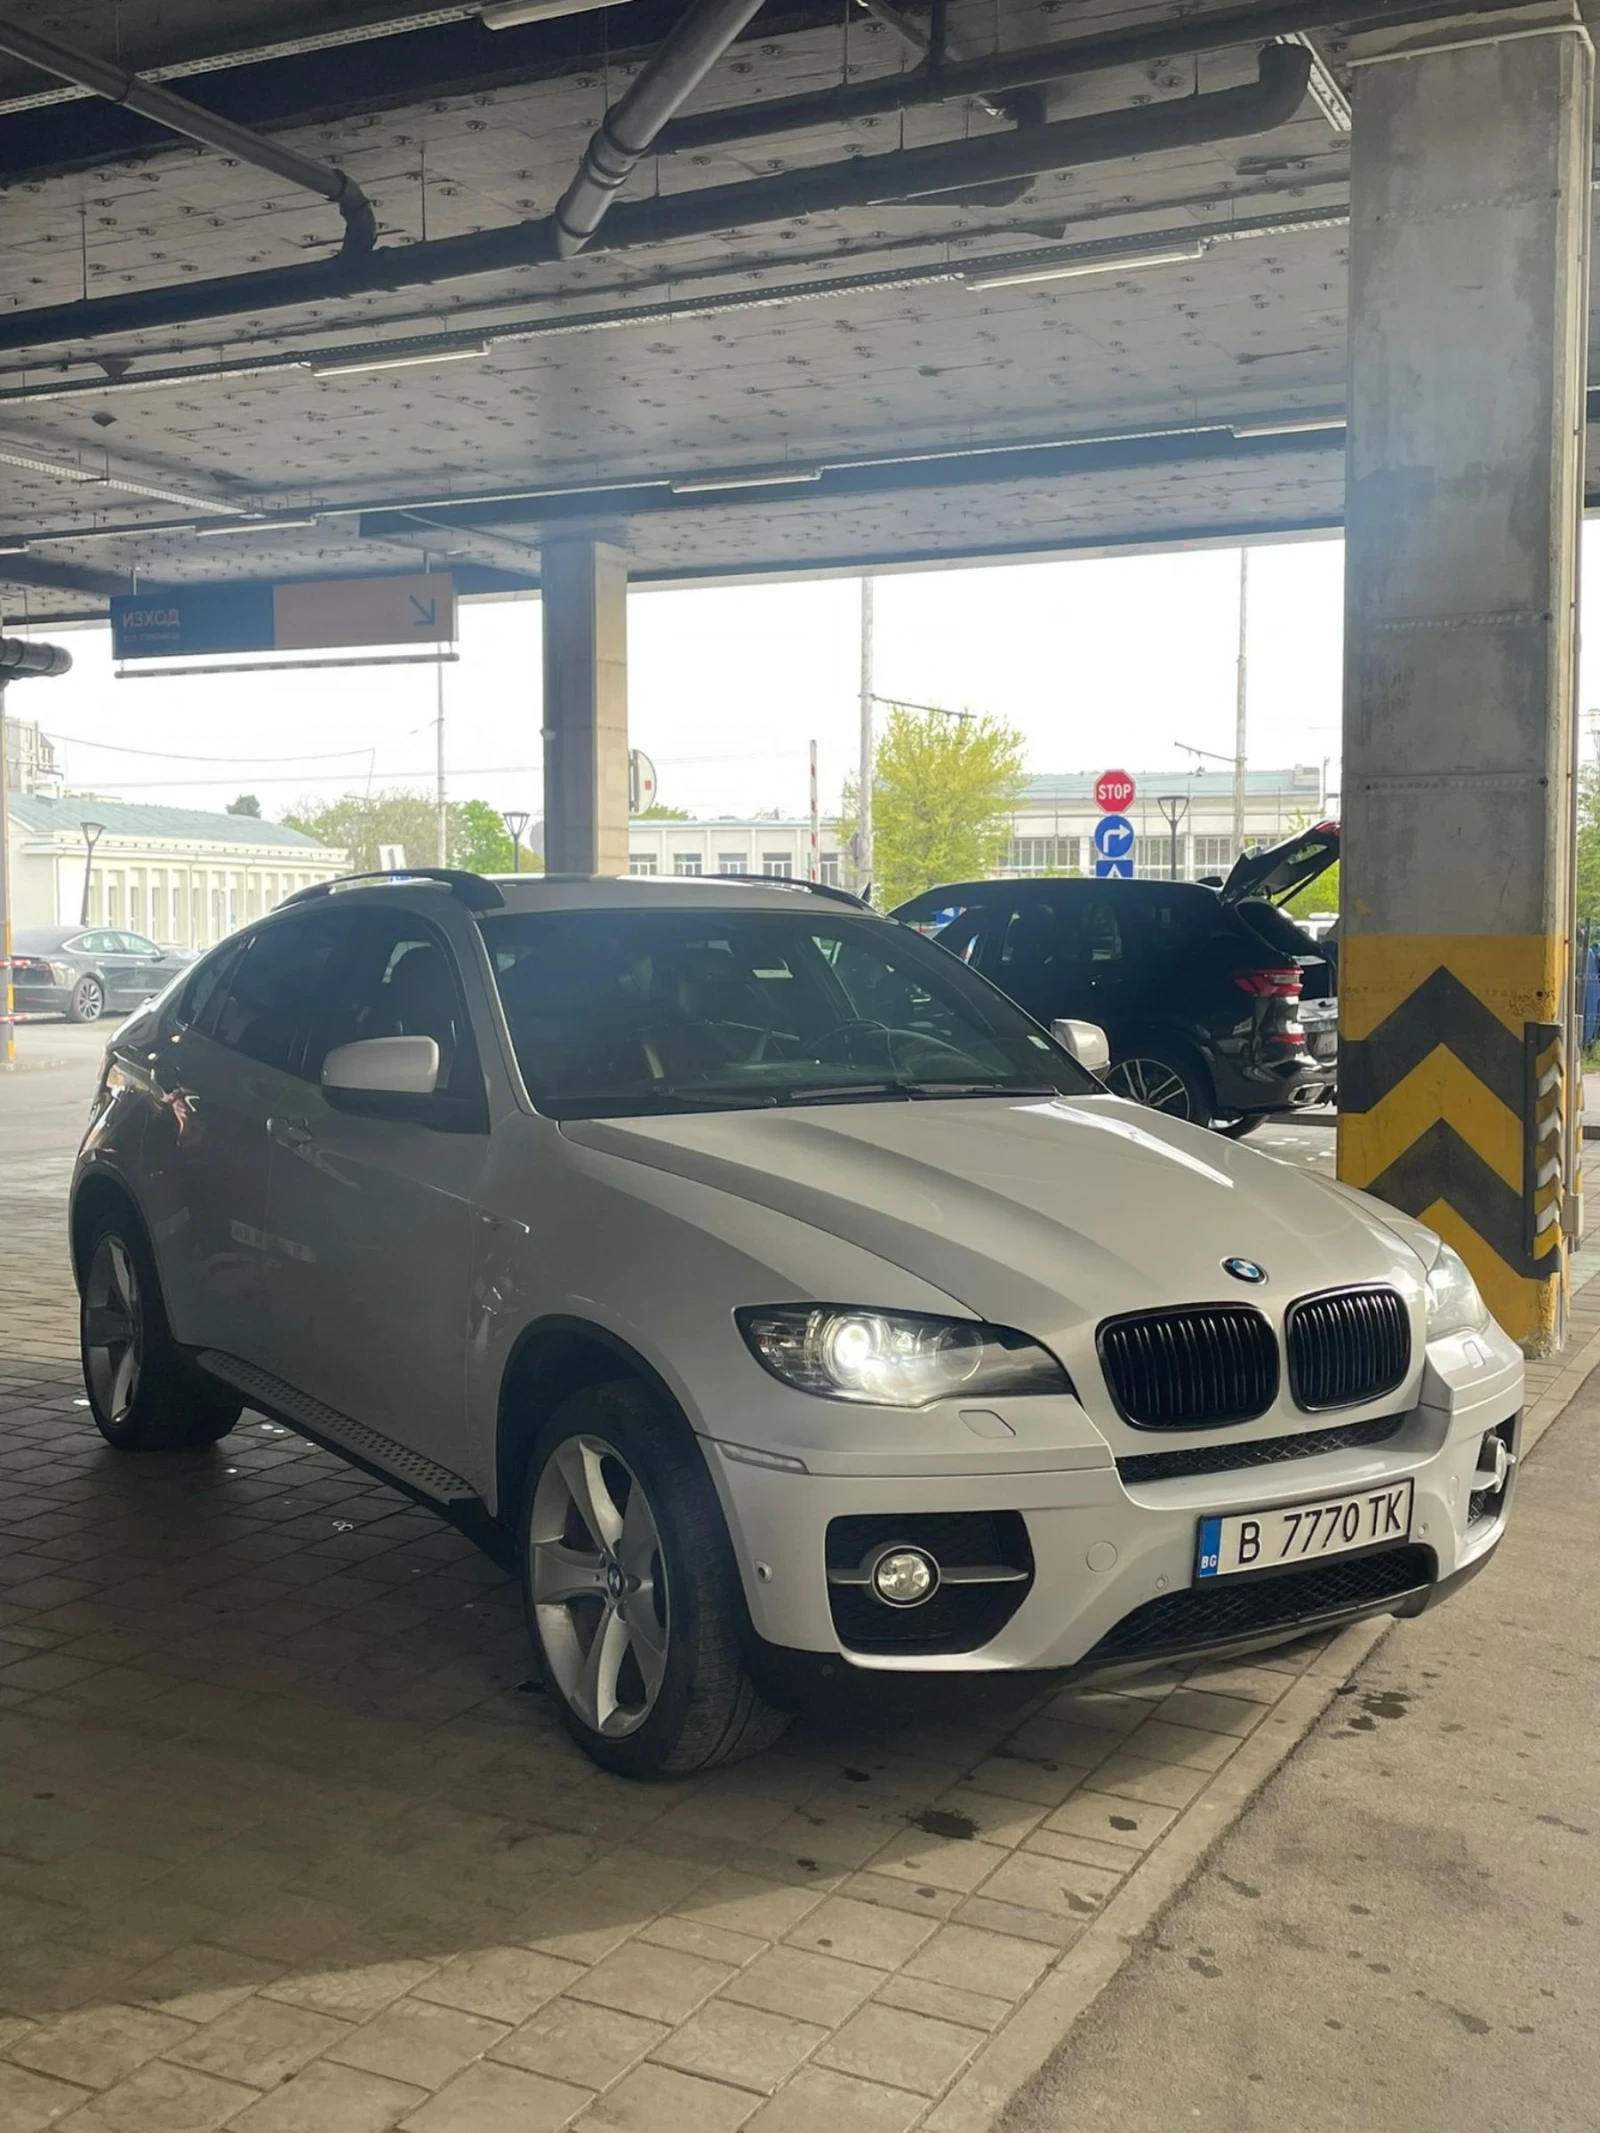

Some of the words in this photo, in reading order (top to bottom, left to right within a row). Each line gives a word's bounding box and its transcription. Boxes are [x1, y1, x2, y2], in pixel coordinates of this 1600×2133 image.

[122, 608, 181, 628] ИЗХОД
[1098, 783, 1132, 800] STOP
[1238, 1521, 1260, 1564] B
[1280, 1502, 1360, 1557] 7770
[1368, 1490, 1404, 1536] TK
[1201, 1554, 1217, 1568] BG
